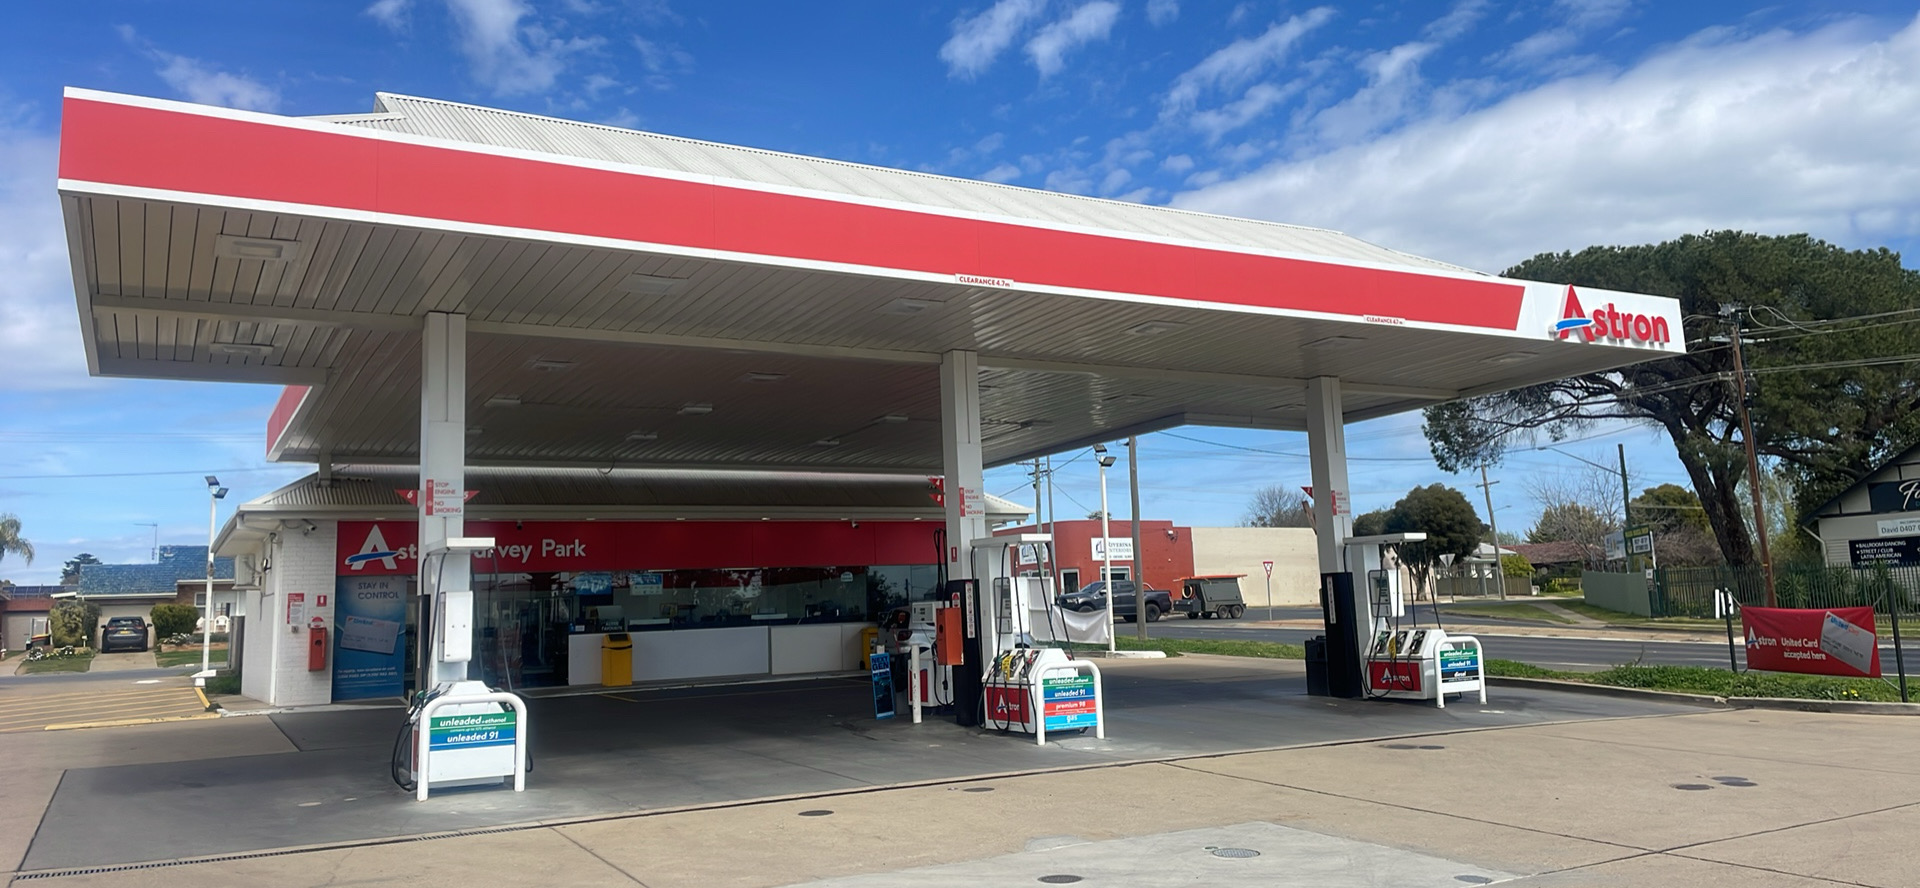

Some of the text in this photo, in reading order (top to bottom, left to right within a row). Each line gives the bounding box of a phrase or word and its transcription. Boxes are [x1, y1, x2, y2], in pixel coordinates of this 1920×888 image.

[959, 276, 995, 286] CLEARANCE
[1555, 283, 1671, 343] Astron
[1366, 316, 1393, 324] CLEARANCE
[406, 490, 413, 499] 6
[1881, 526, 1899, 534] David
[345, 524, 586, 570] Ast arvey Park
[358, 582, 376, 590] STAY
[357, 591, 400, 600] CONTROL
[1747, 626, 1777, 649] Astron
[1781, 637, 1802, 647] United
[1802, 638, 1818, 648] Card
[1783, 650, 1826, 661] accepted here
[1048, 677, 1074, 685] unleaded
[1054, 689, 1079, 698] unleaded
[1056, 702, 1078, 711] premium
[440, 716, 482, 727] unleaded
[1066, 715, 1078, 723] gas
[446, 731, 499, 743] unleaded 91
